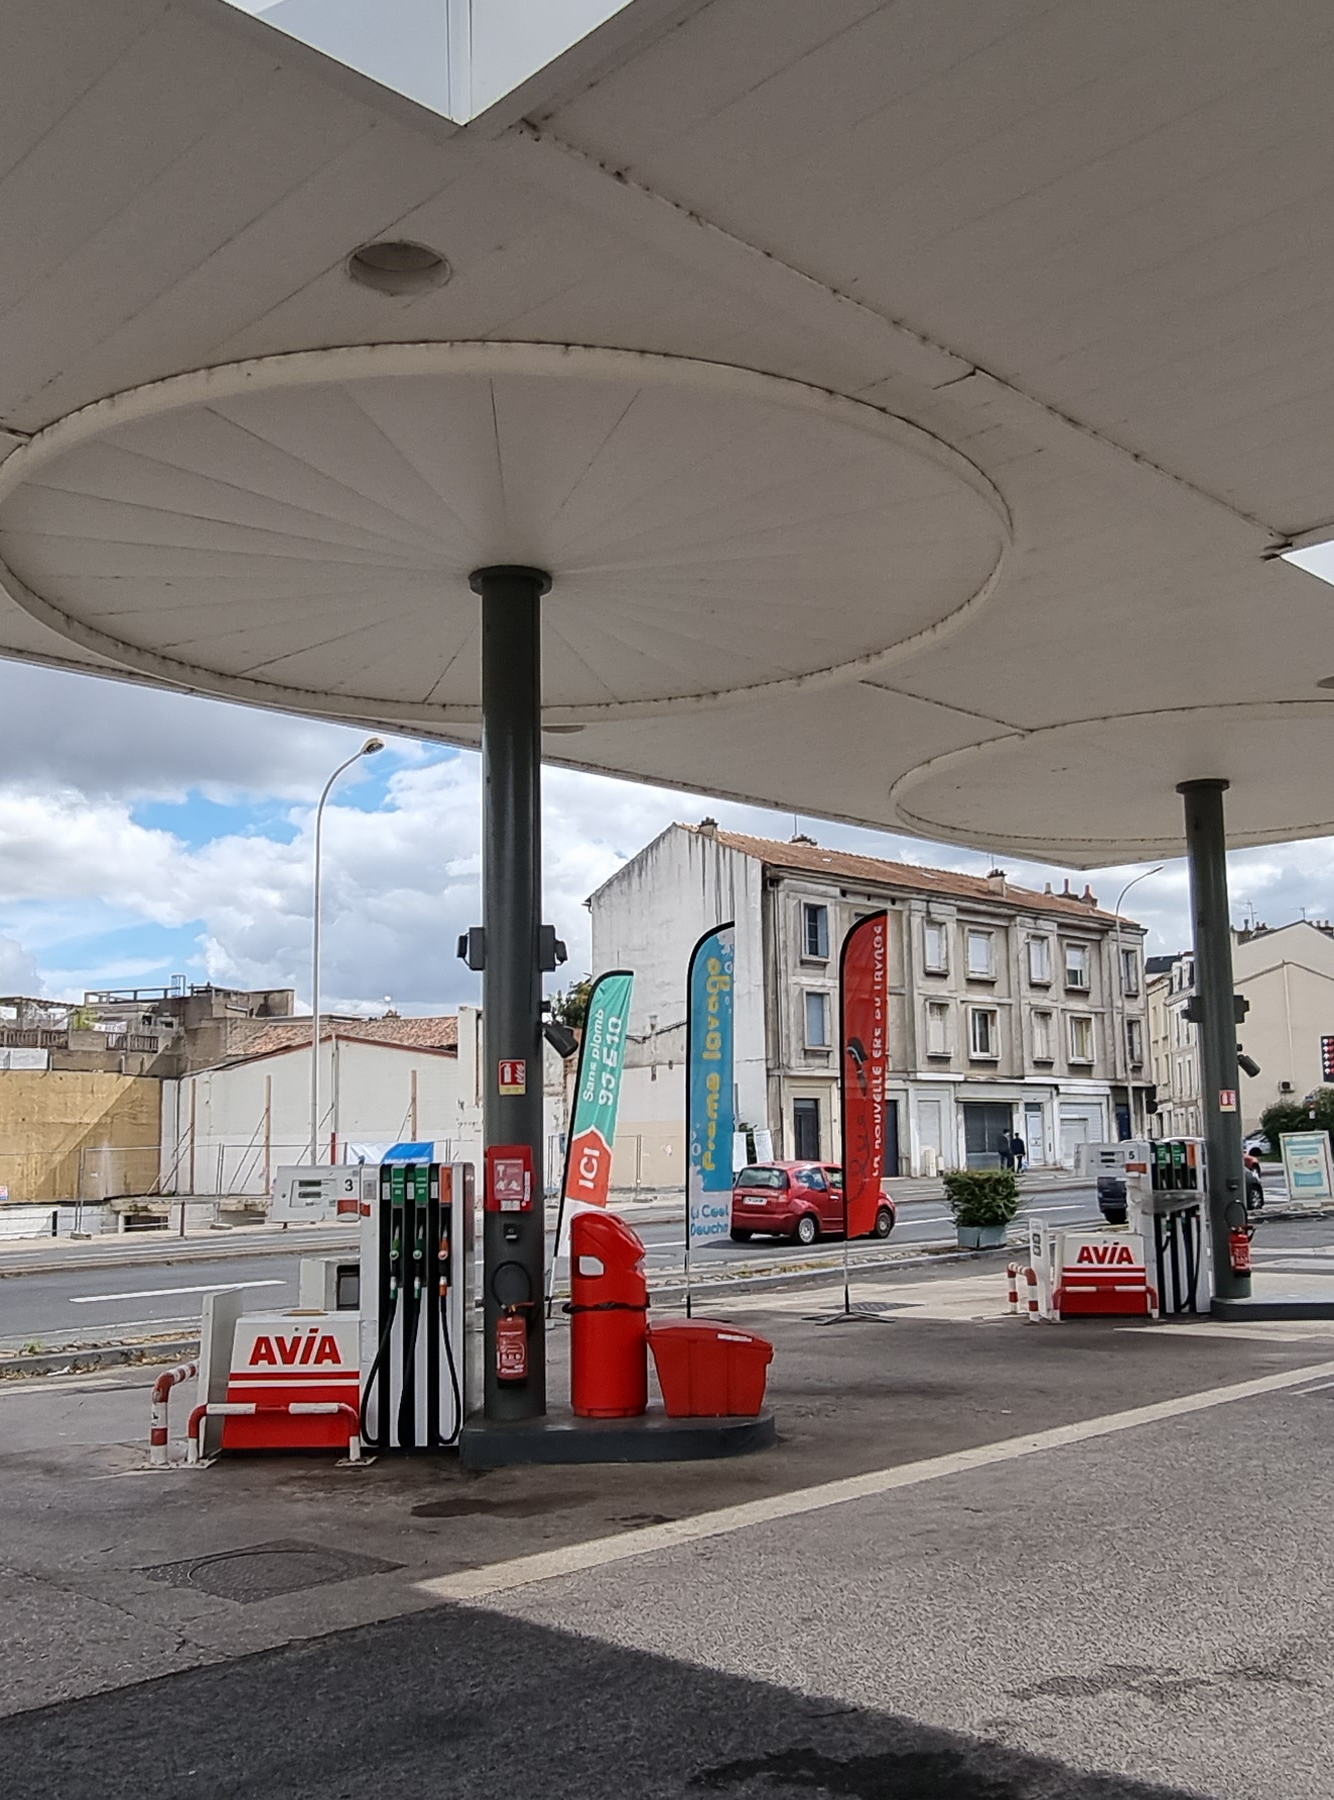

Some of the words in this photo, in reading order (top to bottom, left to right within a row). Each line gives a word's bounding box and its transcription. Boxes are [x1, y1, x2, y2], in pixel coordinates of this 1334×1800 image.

[702, 956, 731, 1061] lavage
[582, 1061, 598, 1102] Sans
[591, 1008, 605, 1058] plomb
[598, 1073, 616, 1106] 95
[872, 1065, 882, 1149] NOUVELLE
[579, 1147, 601, 1190] ICI
[1128, 1150, 1135, 1160] 5
[344, 1178, 354, 1192] 3
[1077, 1241, 1134, 1265] AVIA
[249, 1328, 342, 1366] AVIA
